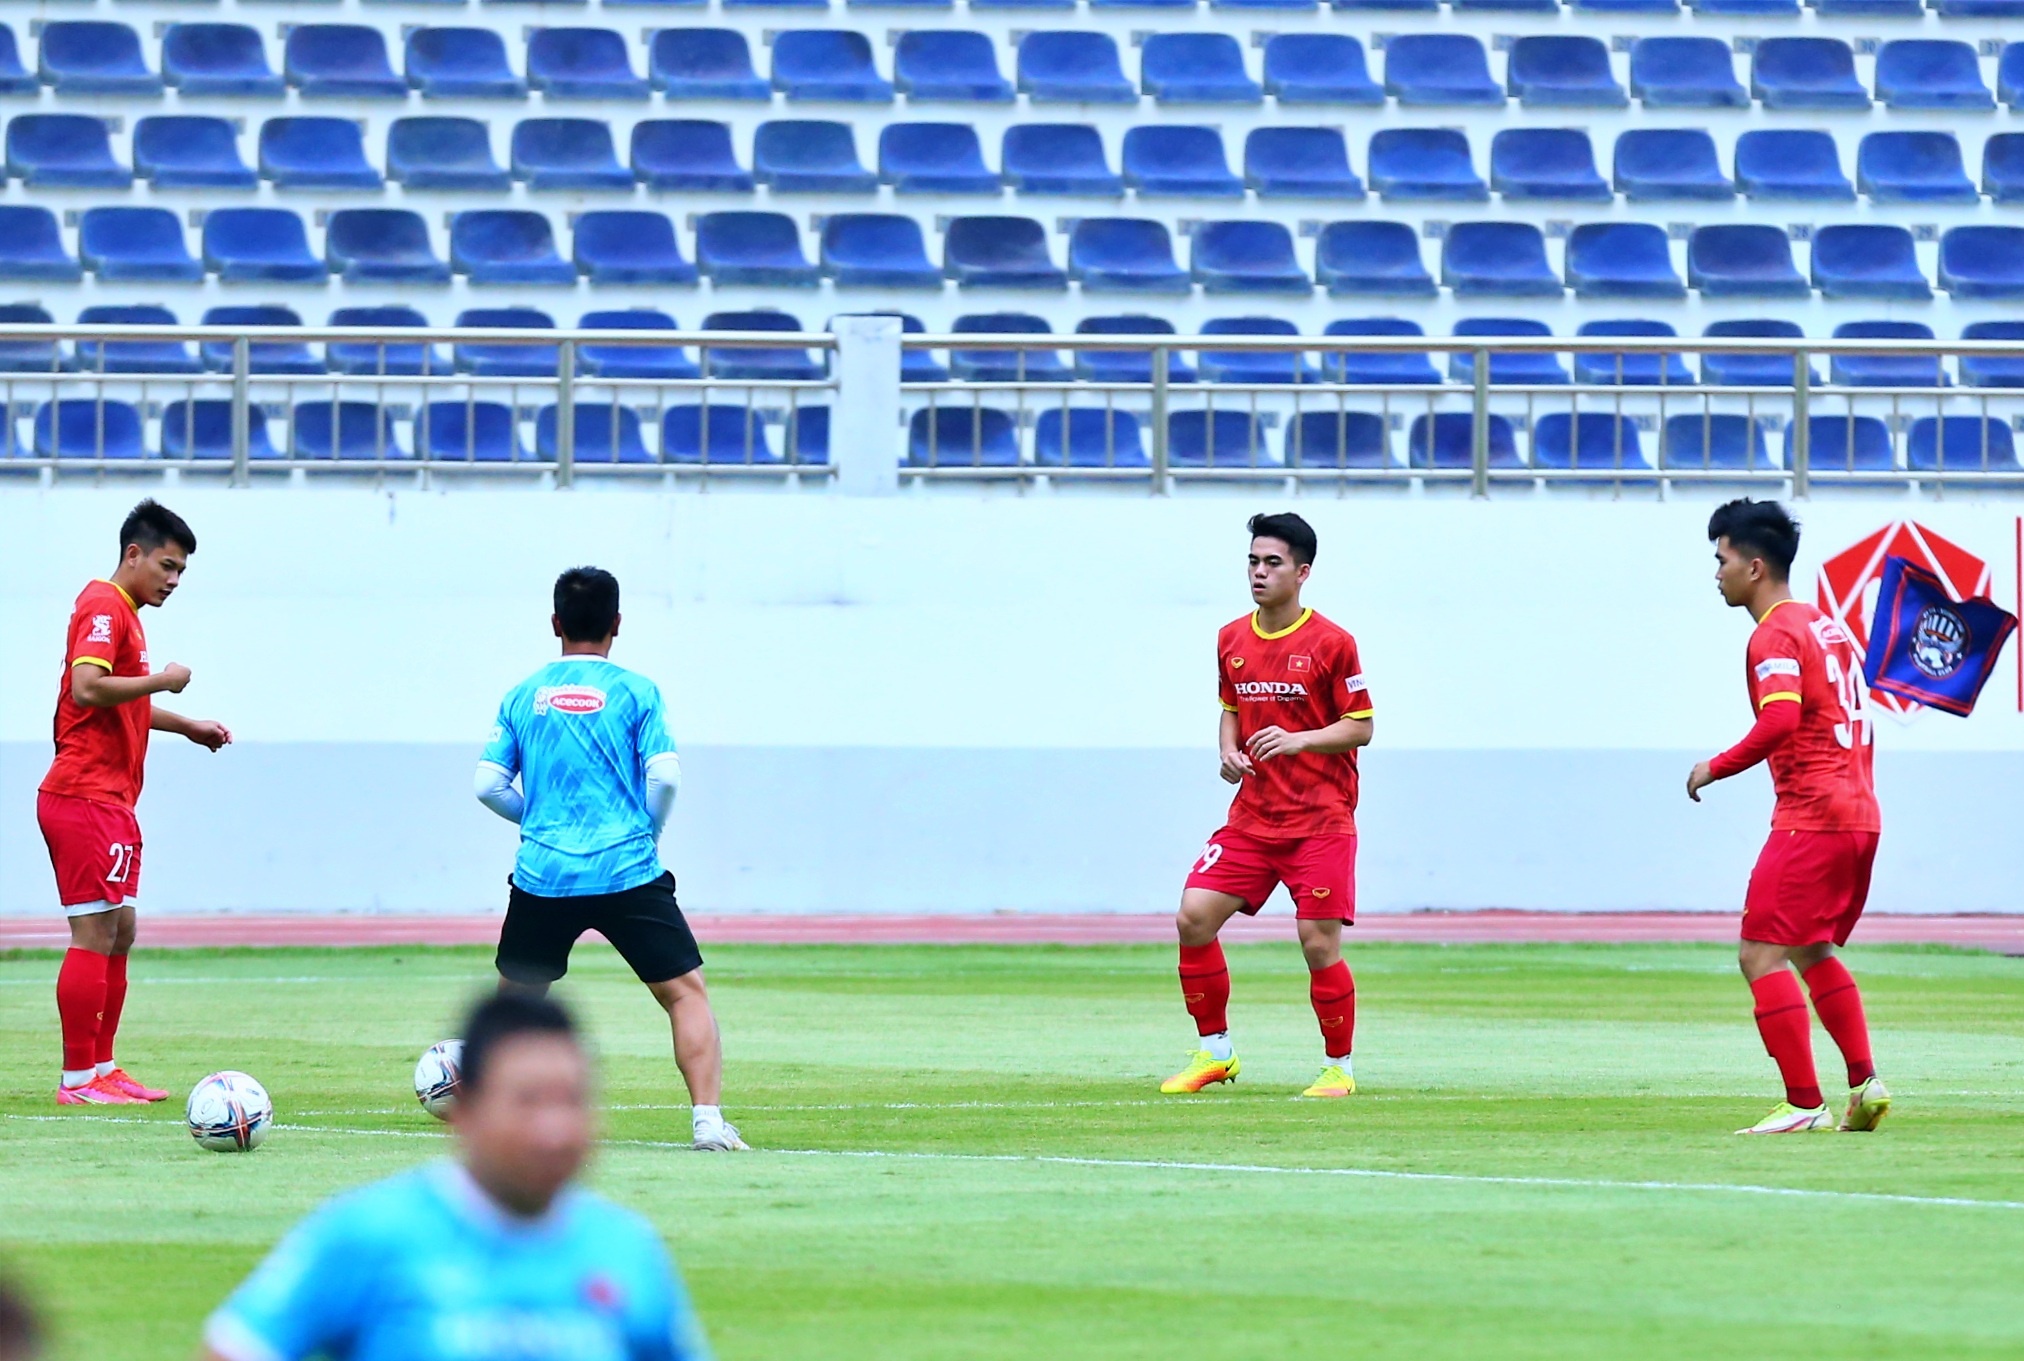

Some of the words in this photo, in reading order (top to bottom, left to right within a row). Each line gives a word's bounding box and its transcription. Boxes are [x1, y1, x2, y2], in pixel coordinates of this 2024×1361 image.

[1794, 225, 1810, 238] 28
[1234, 681, 1308, 696] HONDA
[1825, 651, 1870, 750] 34
[105, 841, 133, 883] 27
